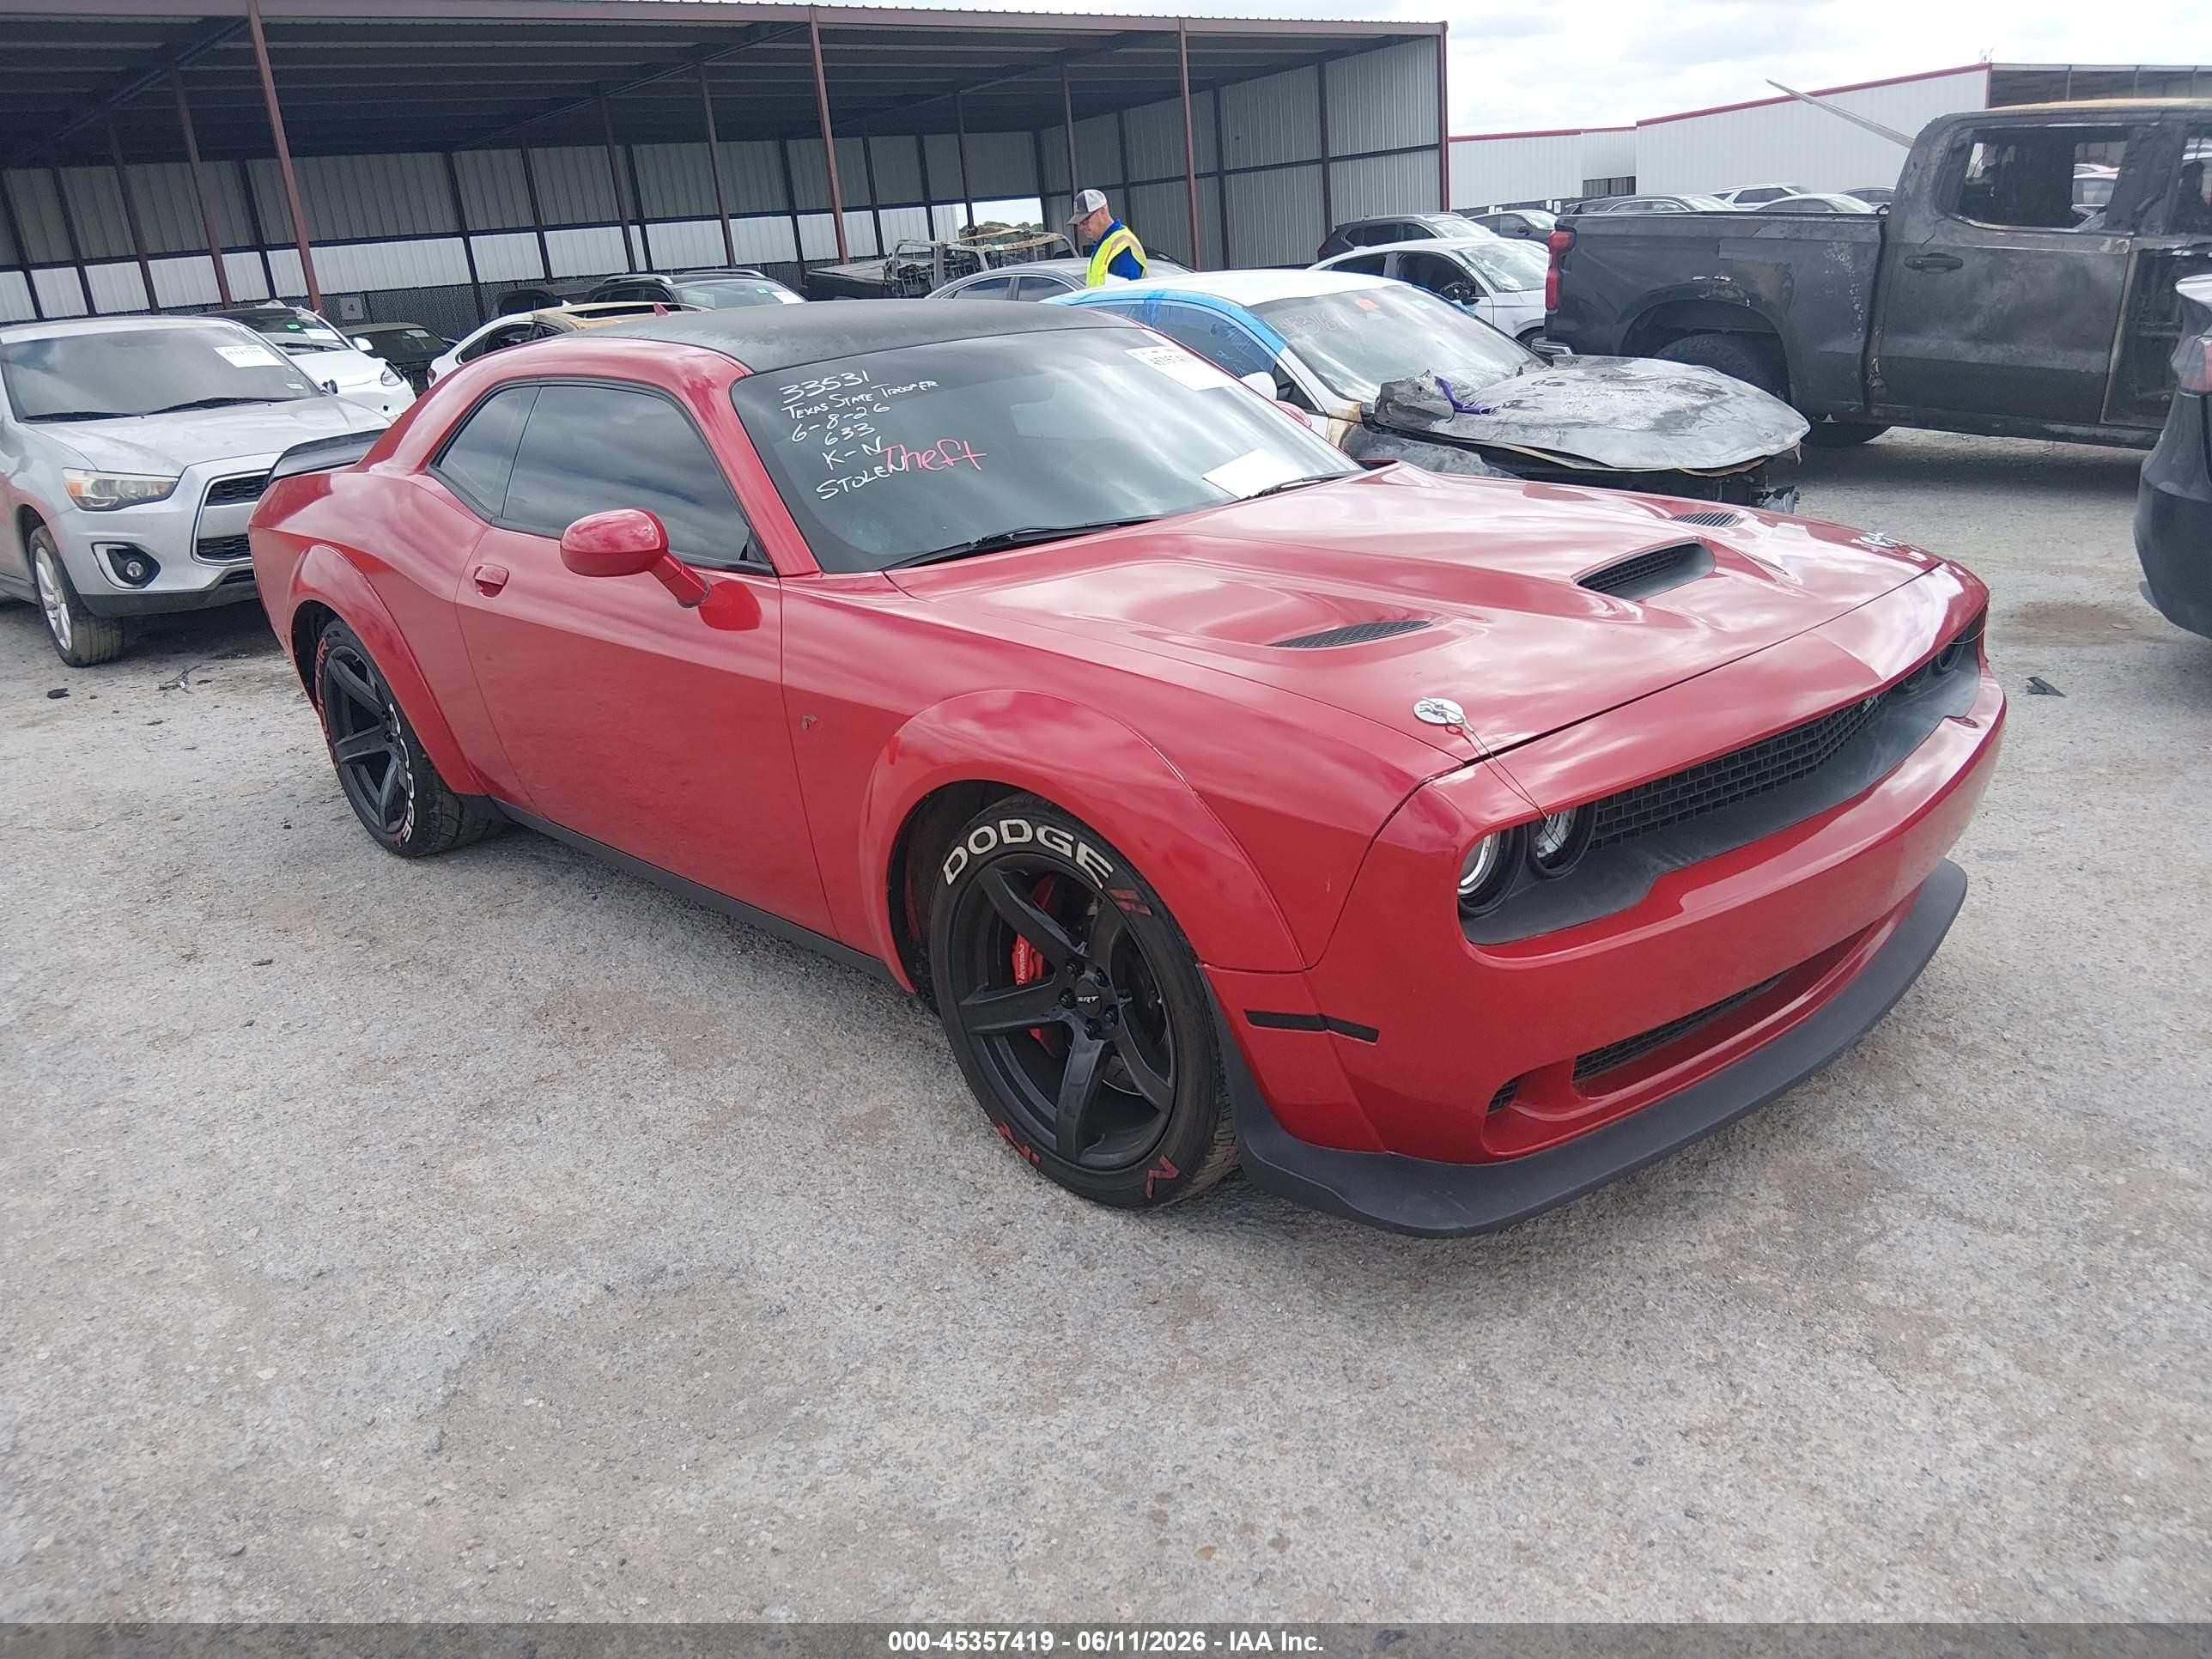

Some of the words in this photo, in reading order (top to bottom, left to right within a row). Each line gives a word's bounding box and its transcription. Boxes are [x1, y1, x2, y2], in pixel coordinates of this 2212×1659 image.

[779, 370, 870, 404] 33531
[781, 402, 830, 420] TEXAS
[829, 393, 874, 409] STATE
[824, 422, 876, 446] 633
[875, 439, 988, 472] Theft
[816, 455, 906, 500] STOLEN
[943, 817, 1114, 889] DODGE
